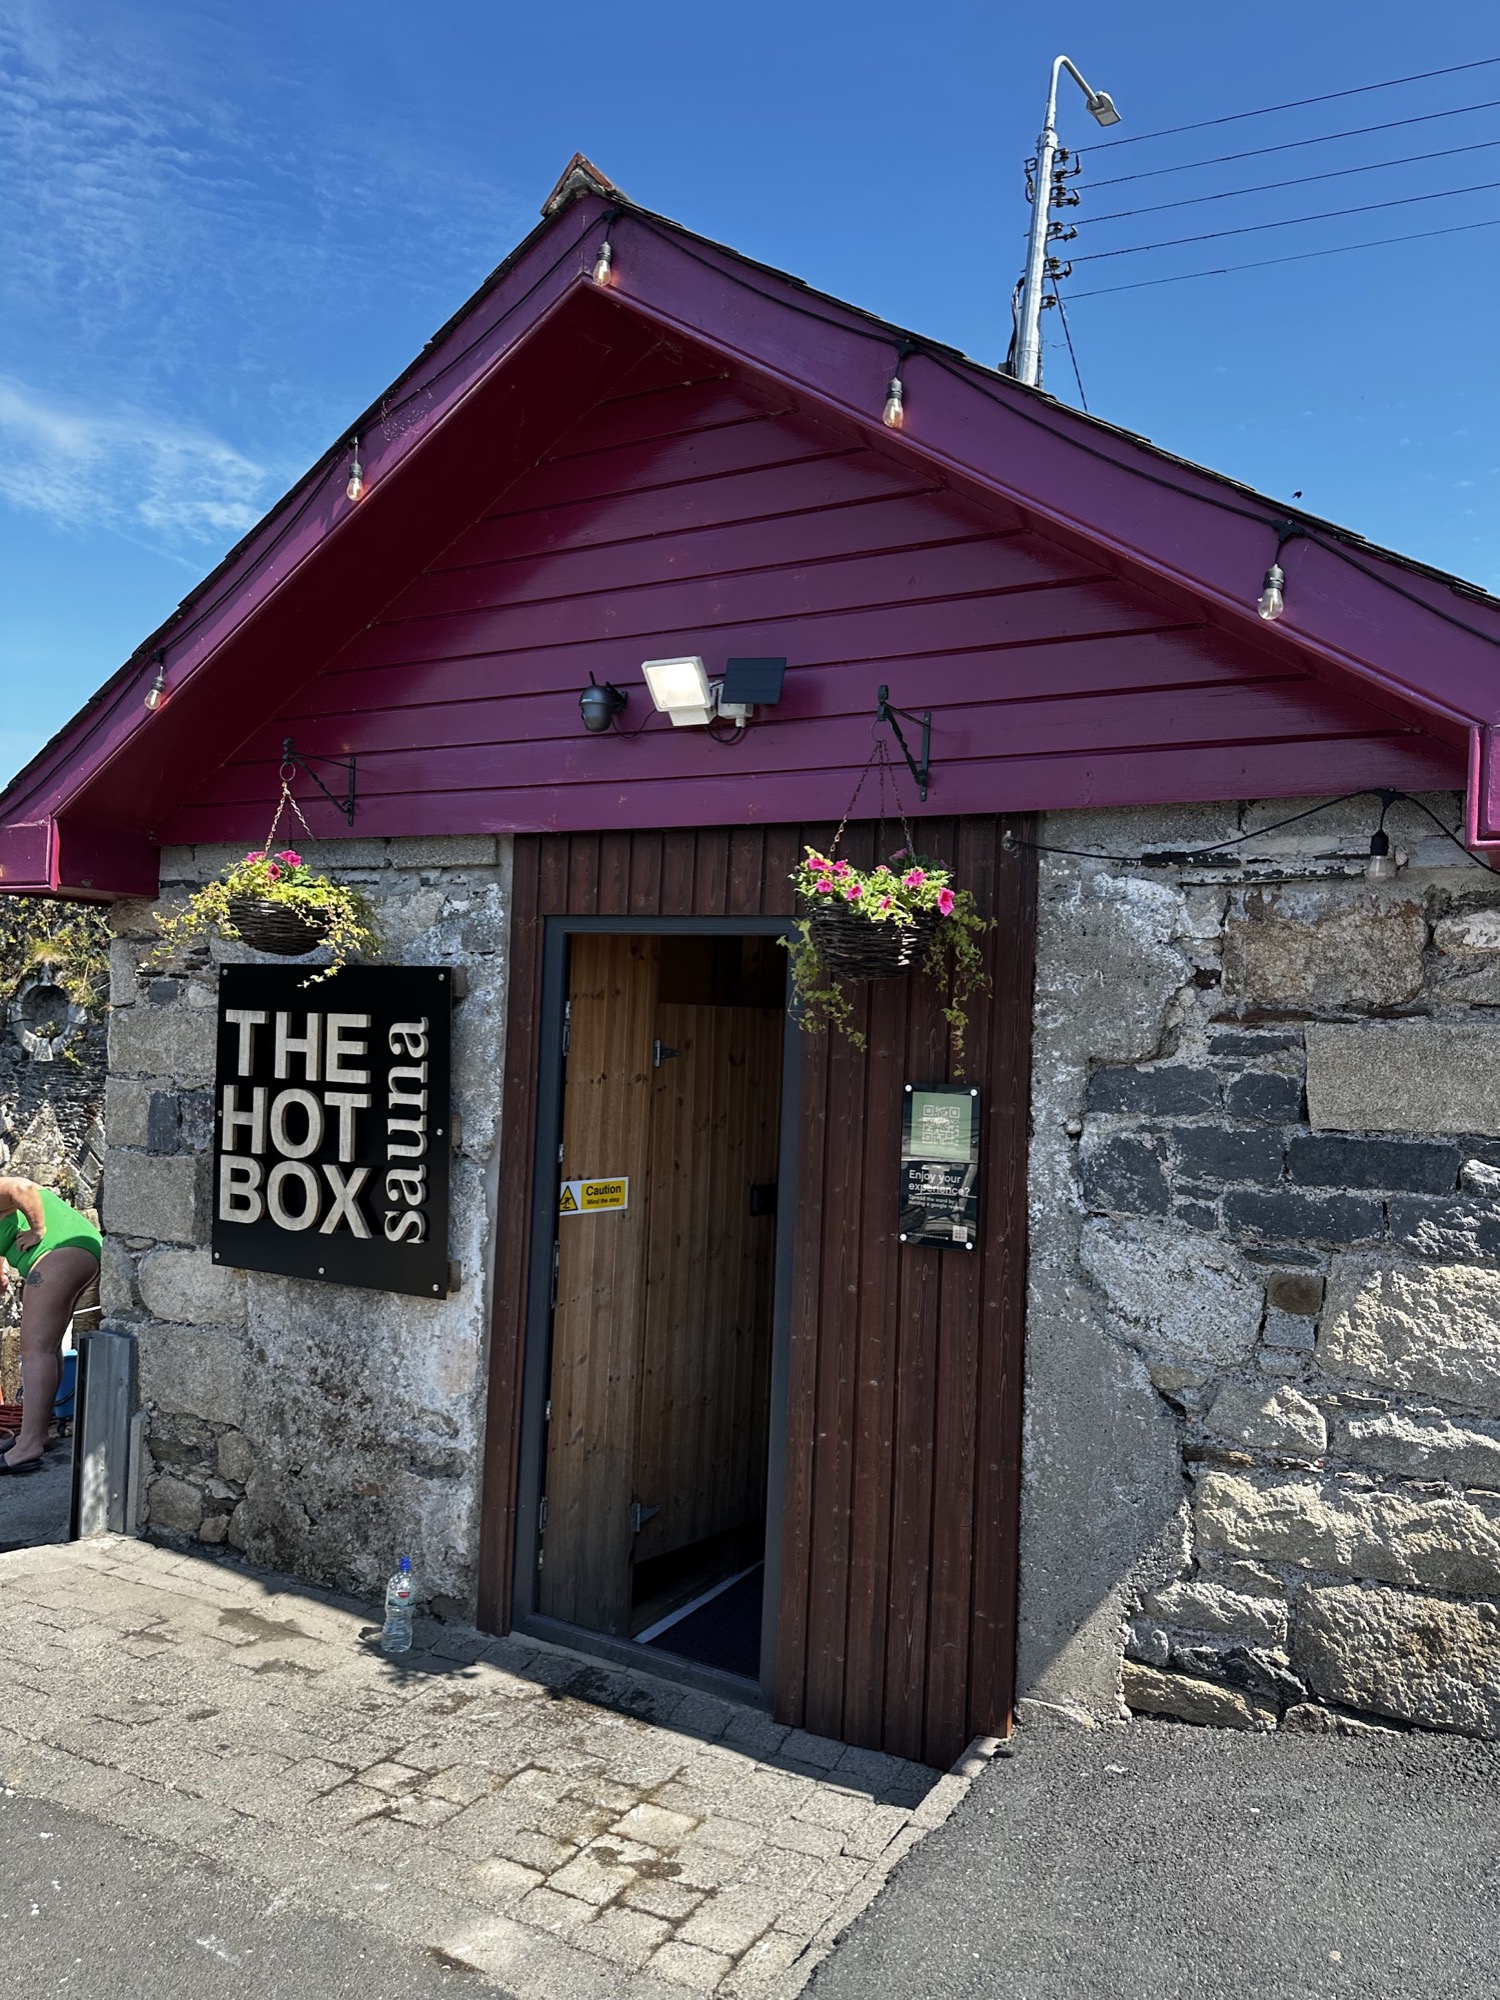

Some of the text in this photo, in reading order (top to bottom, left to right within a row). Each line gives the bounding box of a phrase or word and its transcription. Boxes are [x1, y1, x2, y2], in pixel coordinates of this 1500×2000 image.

[225, 1008, 372, 1084] THE
[222, 1084, 372, 1163] HOT
[384, 1016, 429, 1244] sauna
[219, 1154, 373, 1239] BOX
[586, 1184, 622, 1196] Caution
[908, 1169, 961, 1184] Enjoy your
[908, 1182, 971, 1197] experience?
